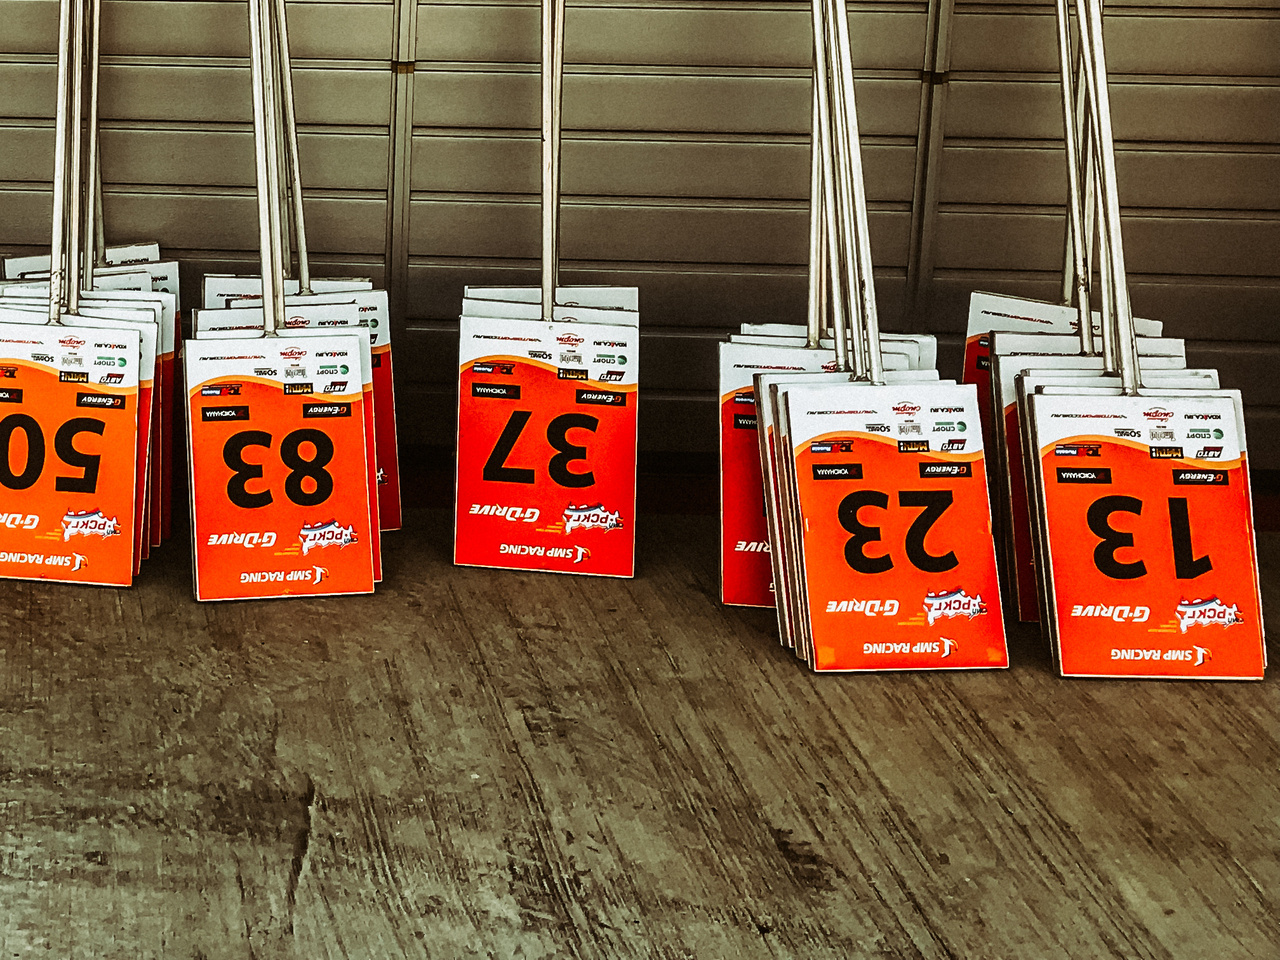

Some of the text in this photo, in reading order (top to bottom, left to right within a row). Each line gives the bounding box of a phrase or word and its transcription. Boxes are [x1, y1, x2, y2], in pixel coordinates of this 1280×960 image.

[475, 386, 506, 394] YOKOHAMA
[483, 411, 598, 487] 37
[223, 429, 333, 508] 83
[838, 491, 958, 573] 23
[1087, 496, 1212, 579] 13
[499, 543, 573, 558] SMP RACING
[0, 551, 71, 566] SMP RACING
[240, 569, 312, 582] SMP RACING
[862, 641, 940, 653] SMP RACING
[1109, 648, 1193, 660] SMP RACING
